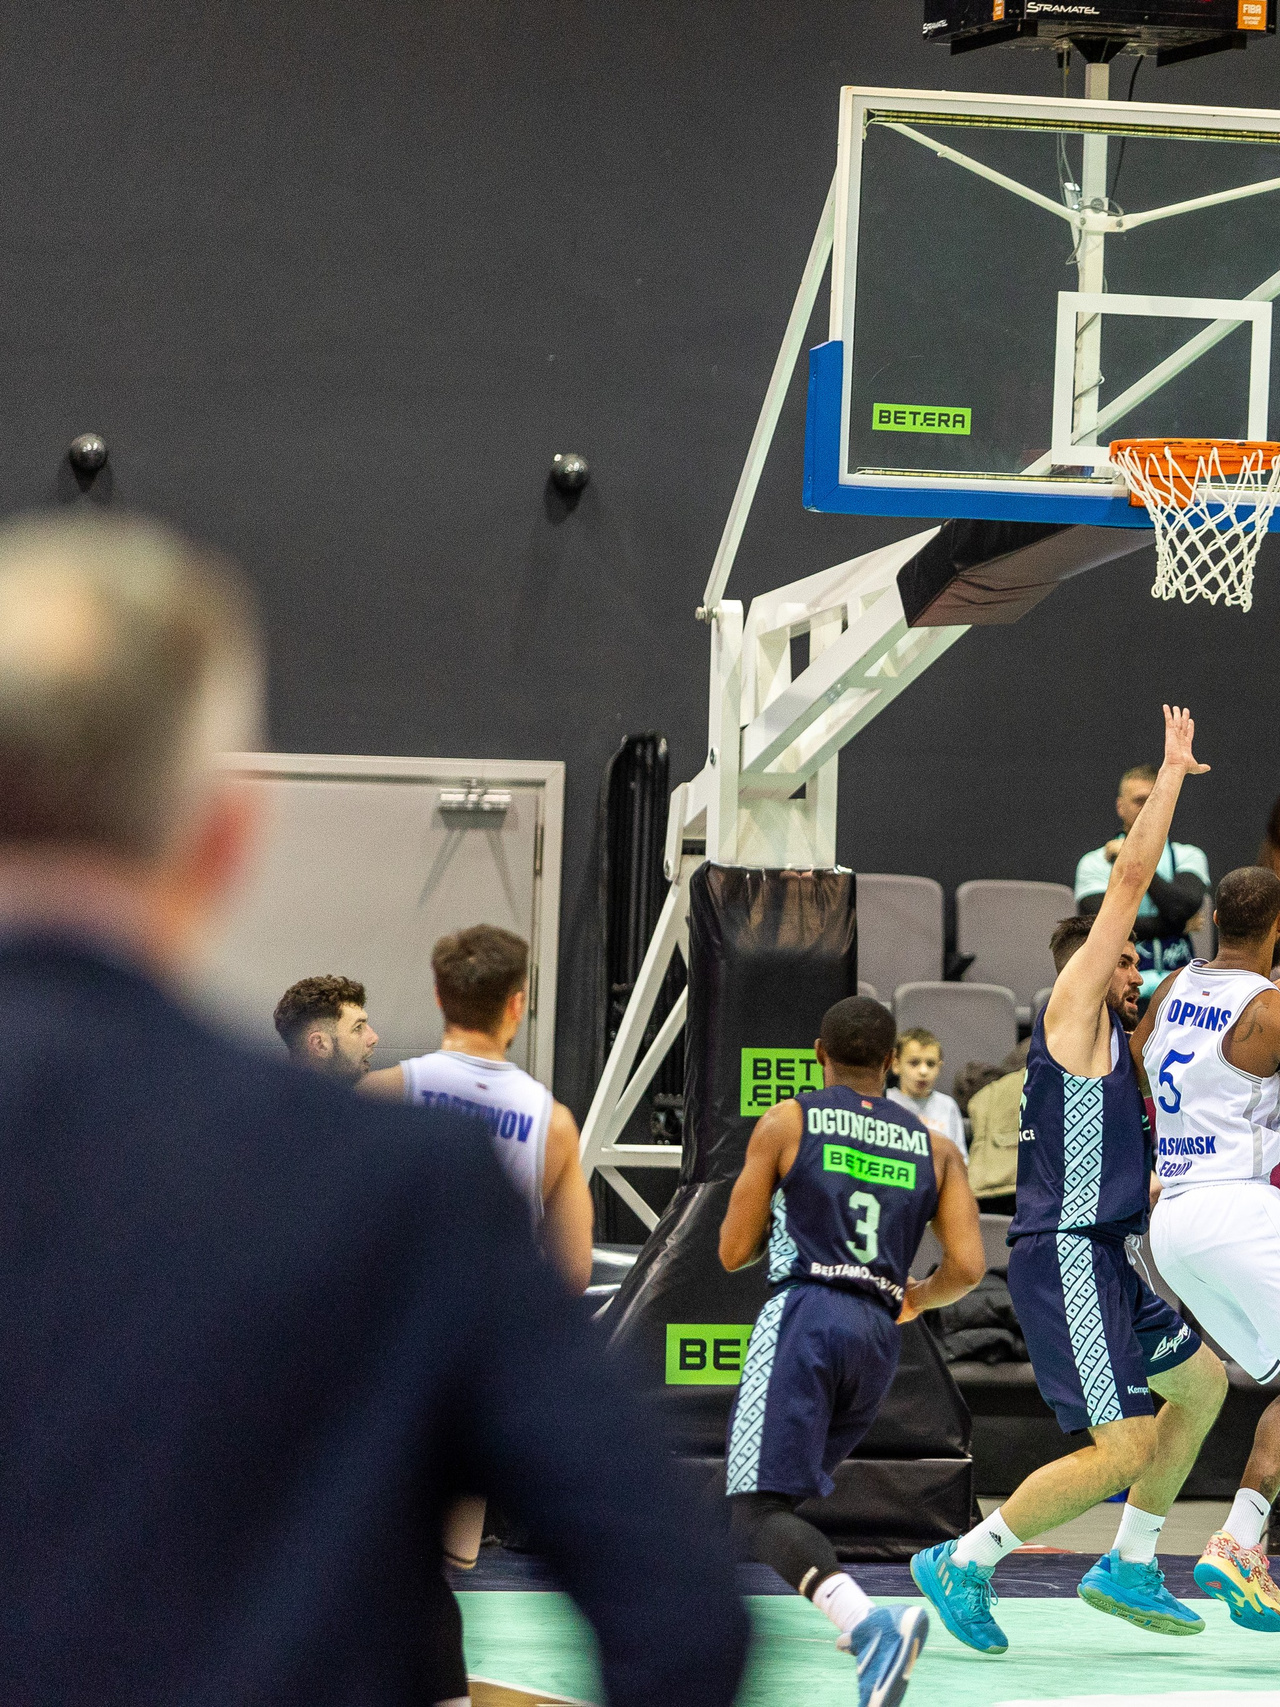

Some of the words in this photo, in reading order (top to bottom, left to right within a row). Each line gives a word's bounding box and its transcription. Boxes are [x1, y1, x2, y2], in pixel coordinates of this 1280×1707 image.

[1026, 2, 1100, 15] STRAMATEL
[1243, 4, 1262, 14] FIBA
[752, 1058, 818, 1081] BET
[1158, 1049, 1195, 1114] 5
[807, 1107, 929, 1156] OGUNGBEMI
[845, 1190, 881, 1264] 3
[679, 1338, 750, 1370] BE
